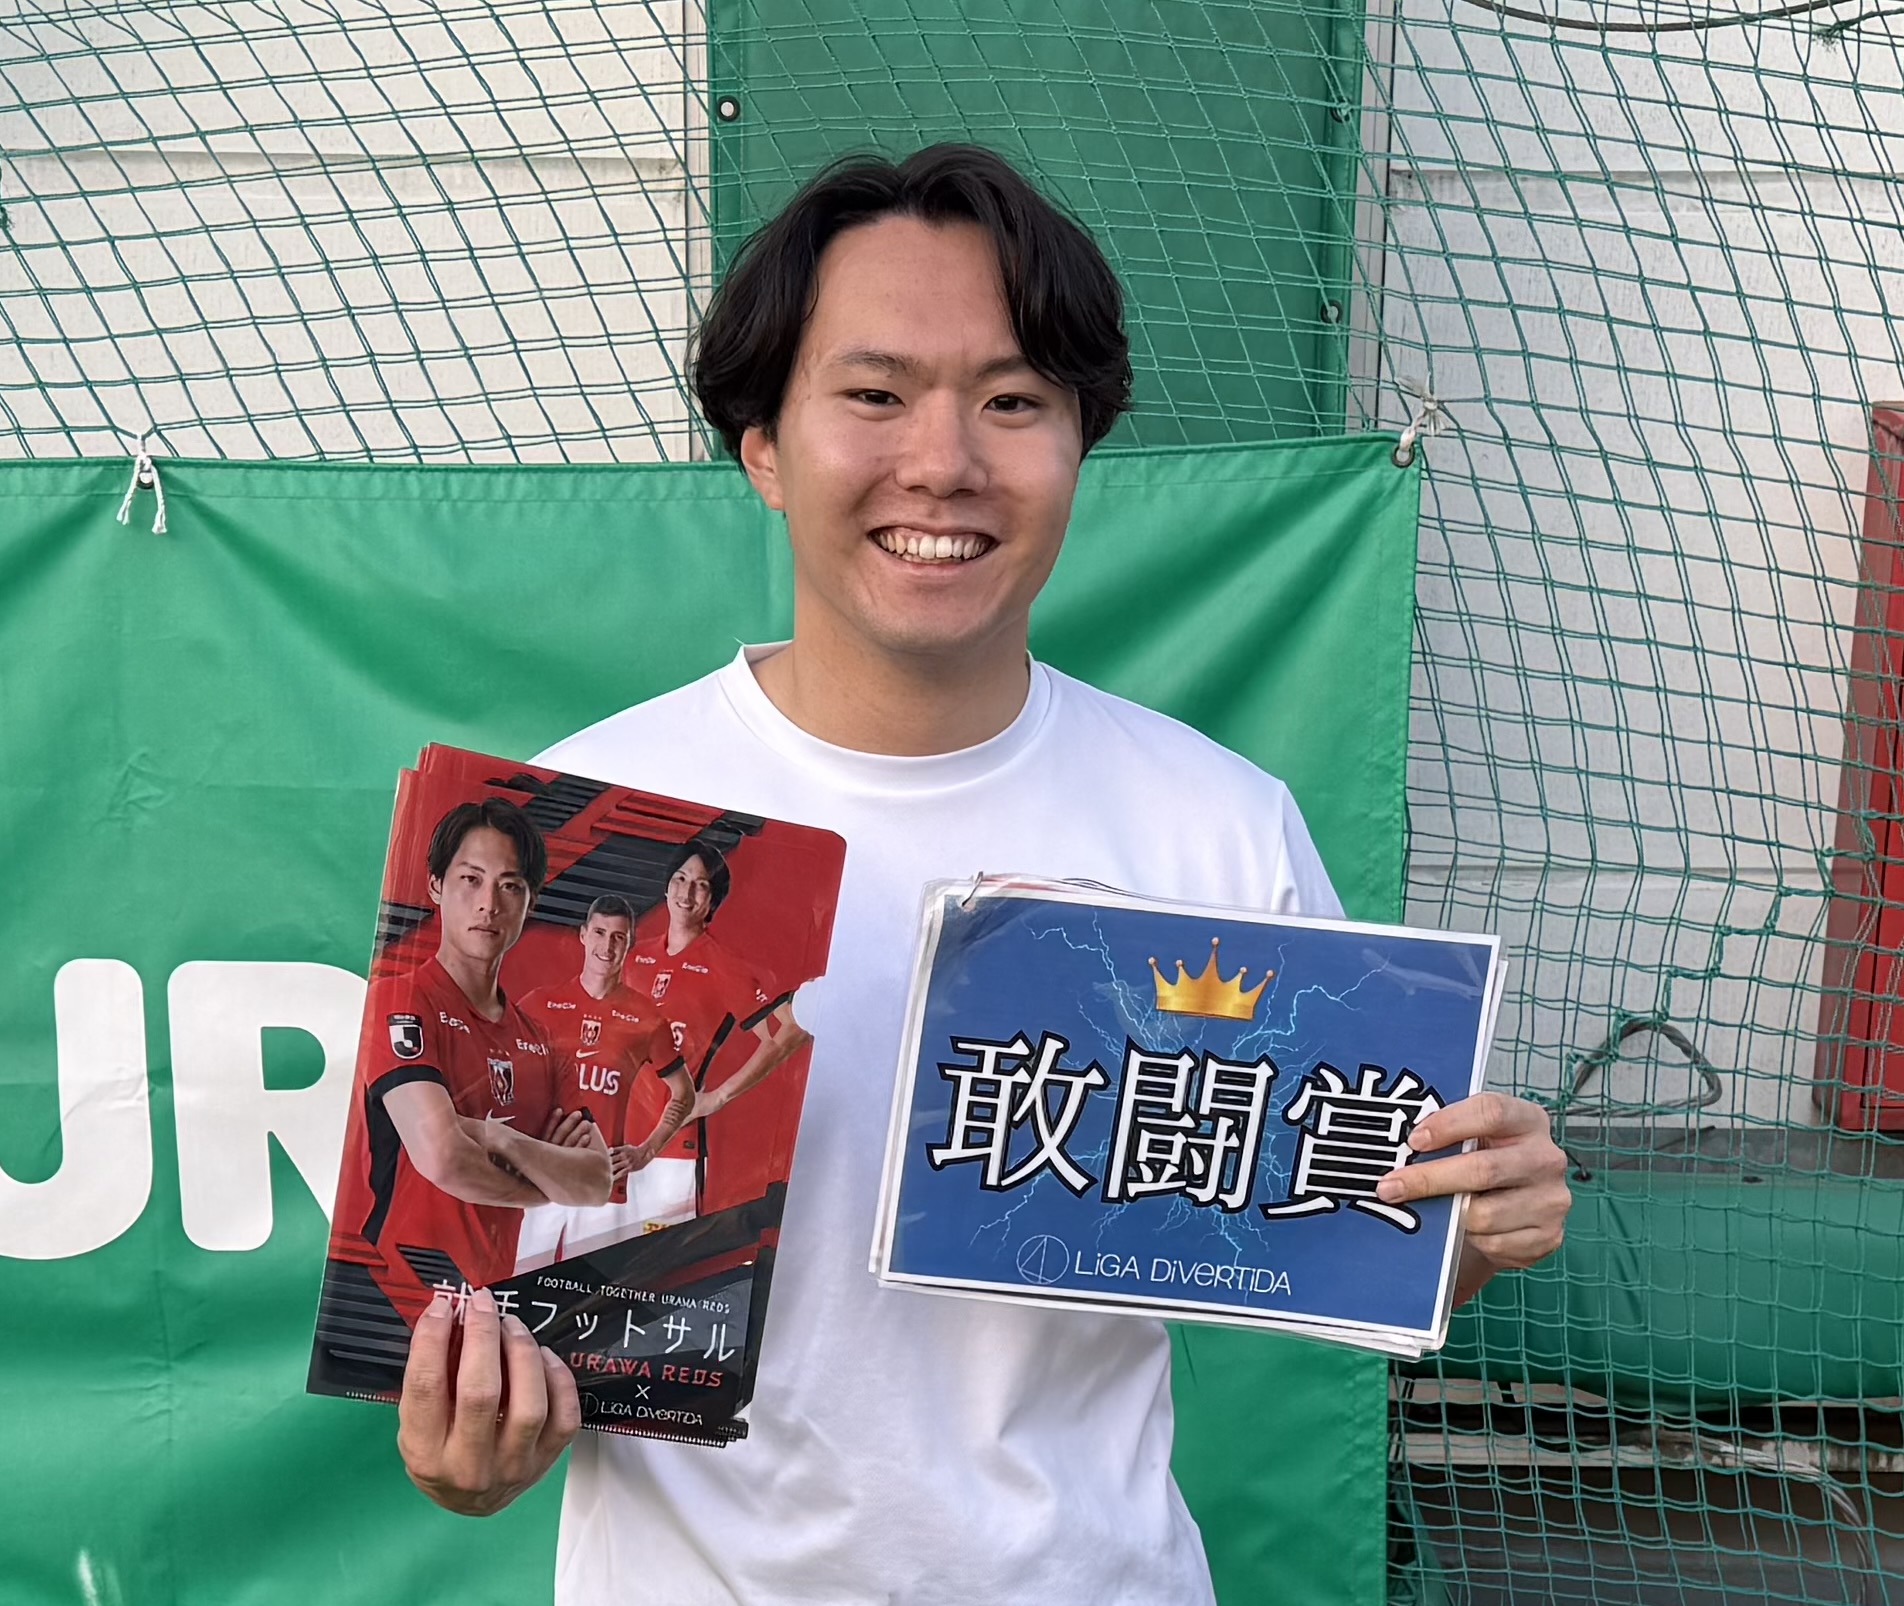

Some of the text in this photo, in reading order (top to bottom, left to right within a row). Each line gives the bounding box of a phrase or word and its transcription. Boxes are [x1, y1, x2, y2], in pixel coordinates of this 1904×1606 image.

[575, 1062, 621, 1096] LUS
[927, 1031, 1447, 1236] 敢闘賞
[537, 1276, 593, 1295] FOOTBALL
[599, 1284, 656, 1304] TOGETHER
[570, 1352, 724, 1388] URAWA REDS
